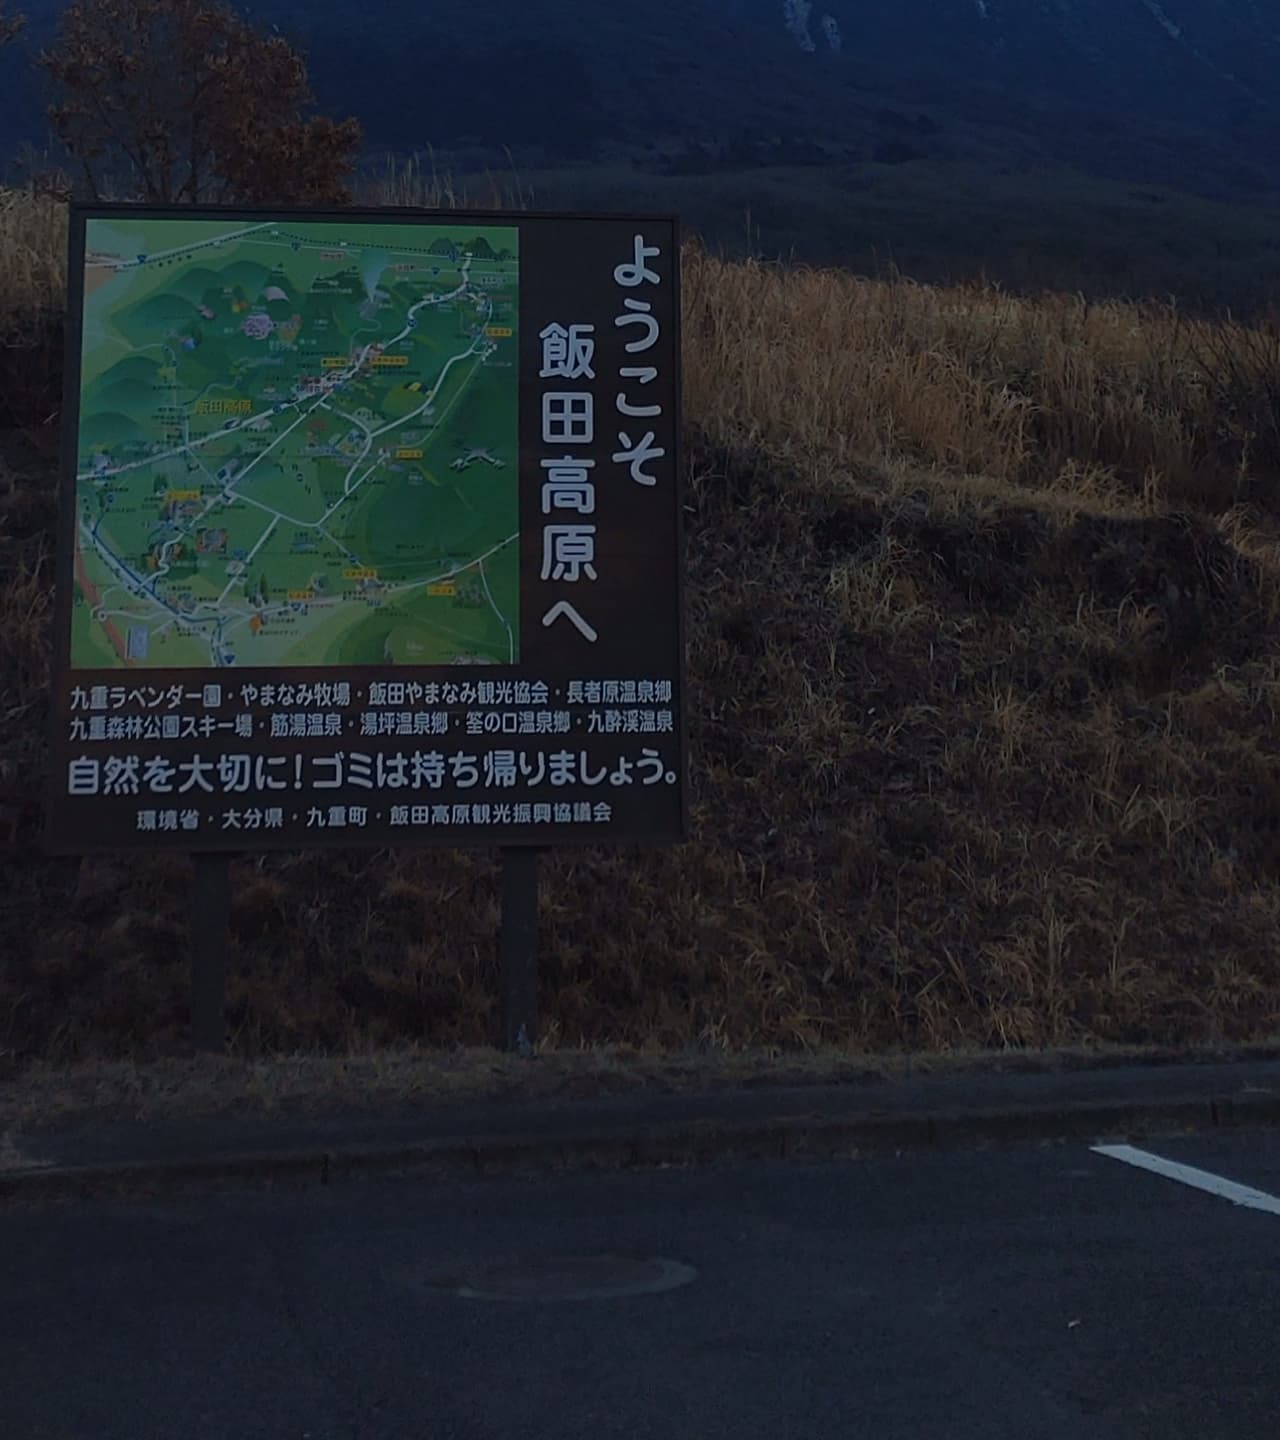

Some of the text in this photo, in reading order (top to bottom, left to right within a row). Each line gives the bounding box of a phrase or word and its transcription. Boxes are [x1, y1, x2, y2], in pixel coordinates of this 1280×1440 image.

[538, 322, 598, 642] 飯田高原へ
[612, 234, 666, 486] ようこそ
